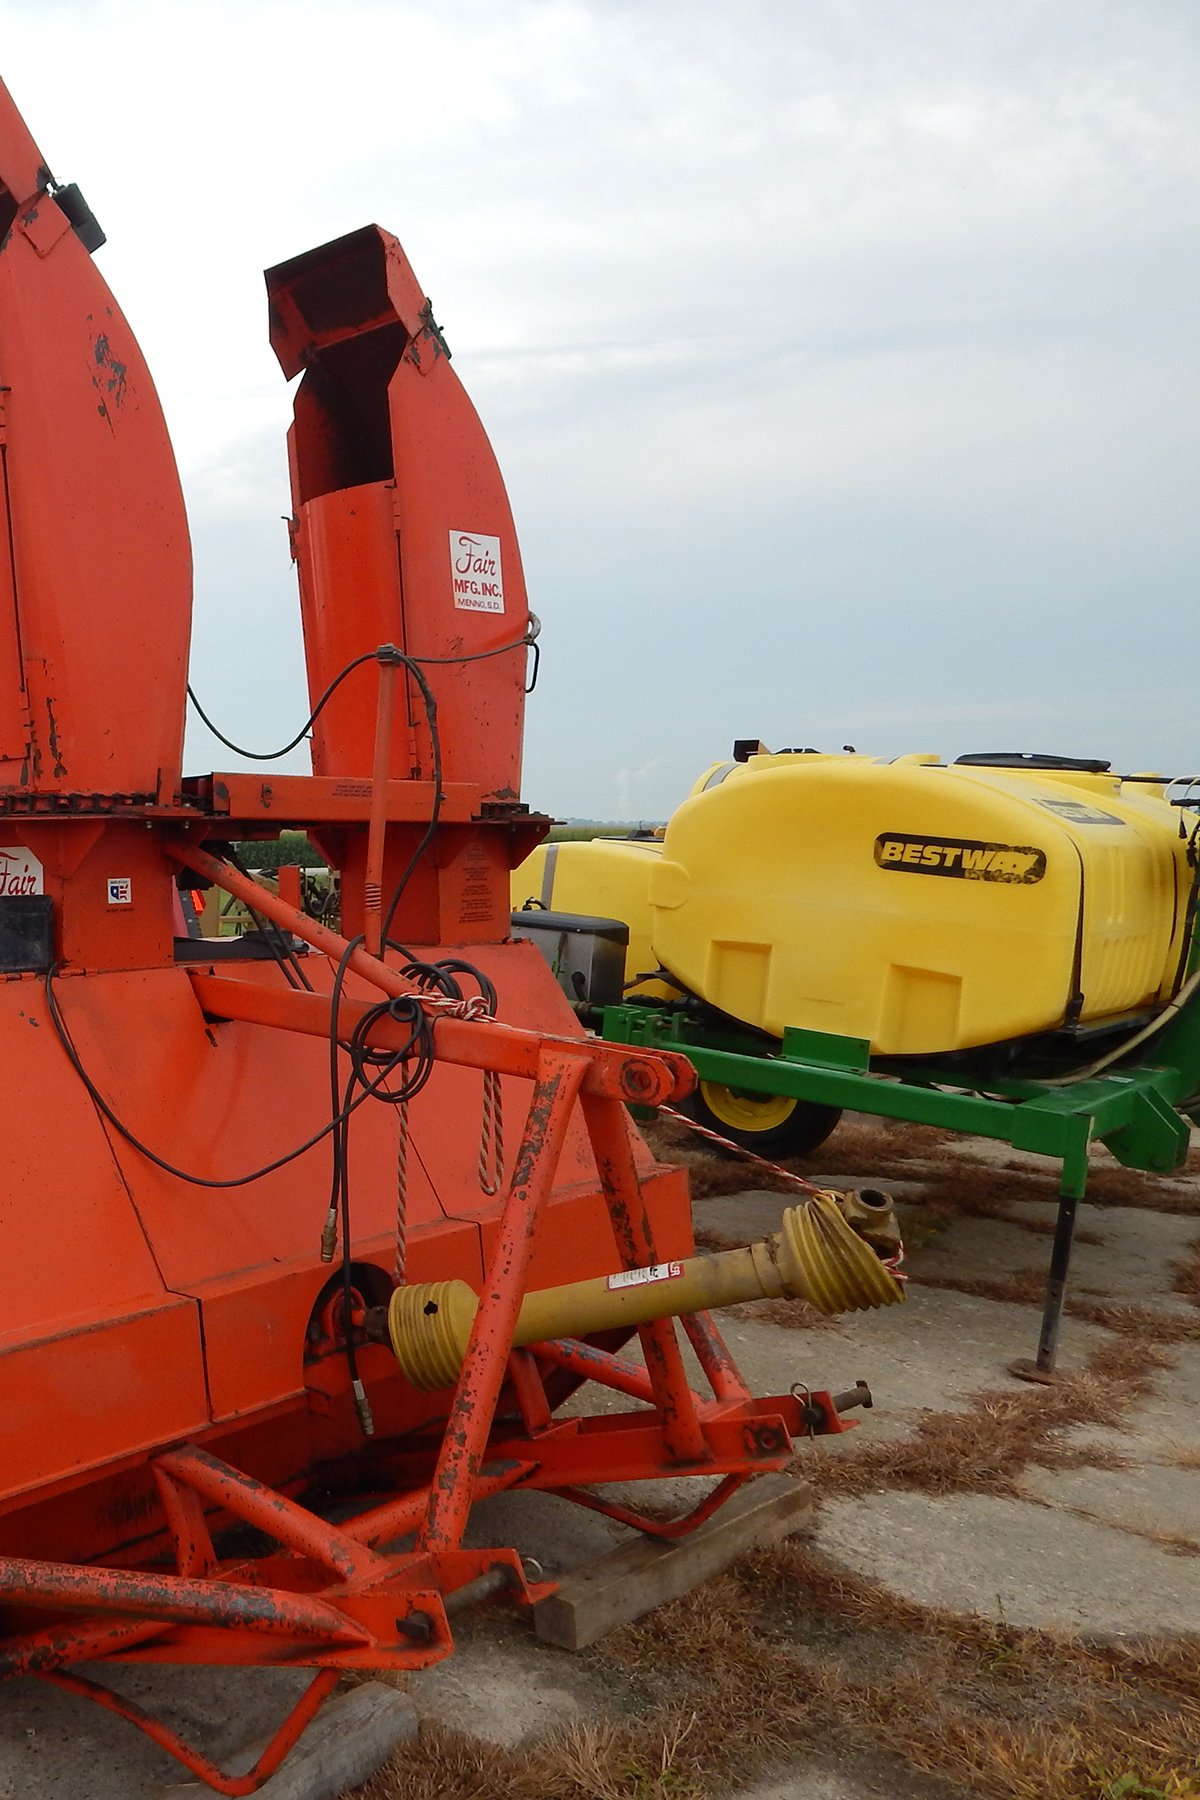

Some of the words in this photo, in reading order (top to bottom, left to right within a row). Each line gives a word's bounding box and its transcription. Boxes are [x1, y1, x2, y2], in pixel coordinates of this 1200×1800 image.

[455, 535, 497, 577] Fair
[454, 579, 481, 595] MFG.
[481, 582, 502, 598] INC.
